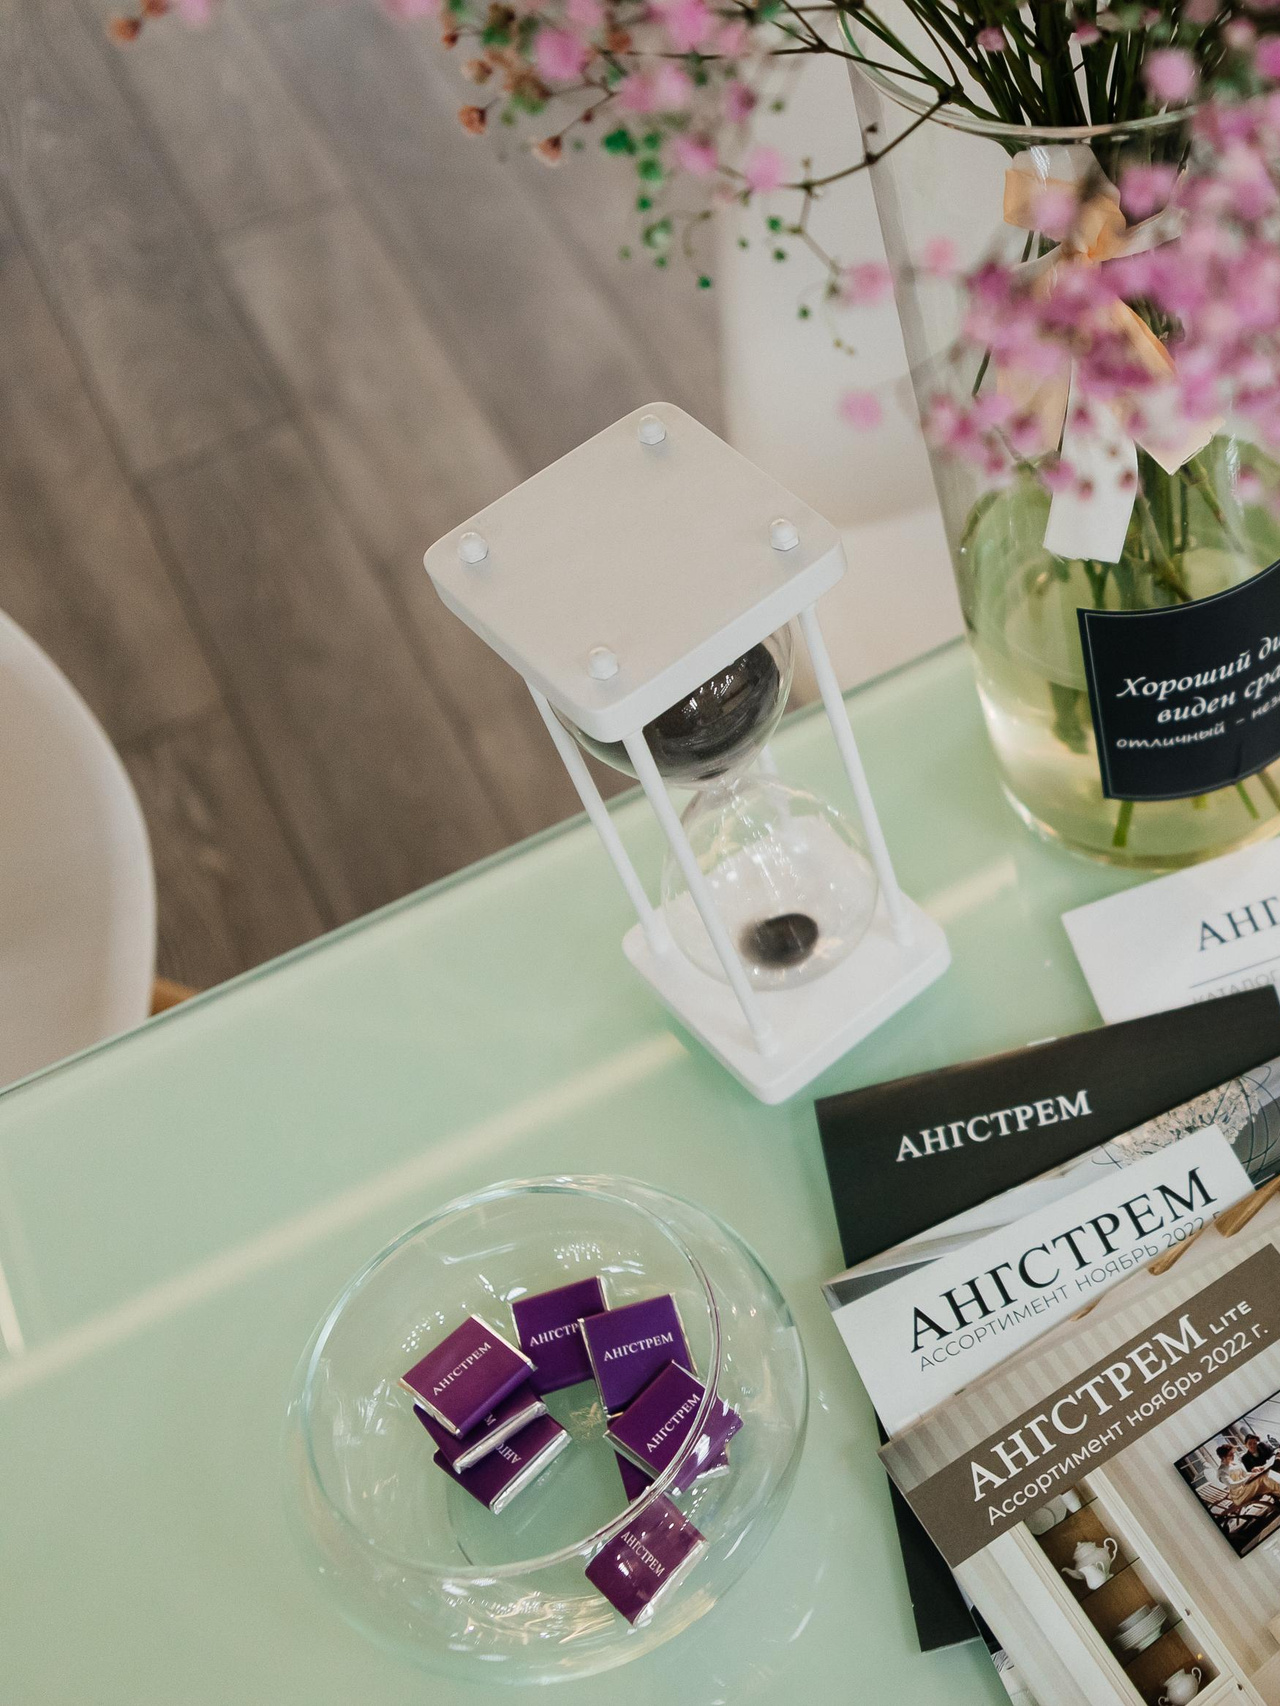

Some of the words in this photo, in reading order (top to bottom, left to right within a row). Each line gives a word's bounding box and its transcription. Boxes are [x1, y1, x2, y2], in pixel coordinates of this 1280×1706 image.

[1116, 650, 1251, 701] Хороший
[1116, 721, 1226, 749] отличный
[1157, 692, 1236, 724] виден
[896, 1089, 1093, 1163] АНГСТРЕМ
[910, 1166, 1218, 1354] АНГСТРЕМ
[529, 1322, 579, 1348] АНГСТР
[919, 1284, 1071, 1372] АССОРТИМЕНТ
[1076, 1244, 1159, 1292] НОЯБРЬ
[432, 1341, 492, 1397] АНГСТРЕМ
[603, 1331, 674, 1363] АНГСТРЕМ
[645, 1392, 701, 1453] АНГСТРЕМ
[970, 1313, 1209, 1503] АНГСТРЕМ
[1208, 1299, 1254, 1337] LITE
[987, 1423, 1126, 1528] Ассортимент
[1126, 1368, 1204, 1432] ноябрь
[1200, 1330, 1253, 1376] 2022
[1251, 1320, 1270, 1344] г.
[620, 1530, 666, 1578] АНГСТРЕМ
